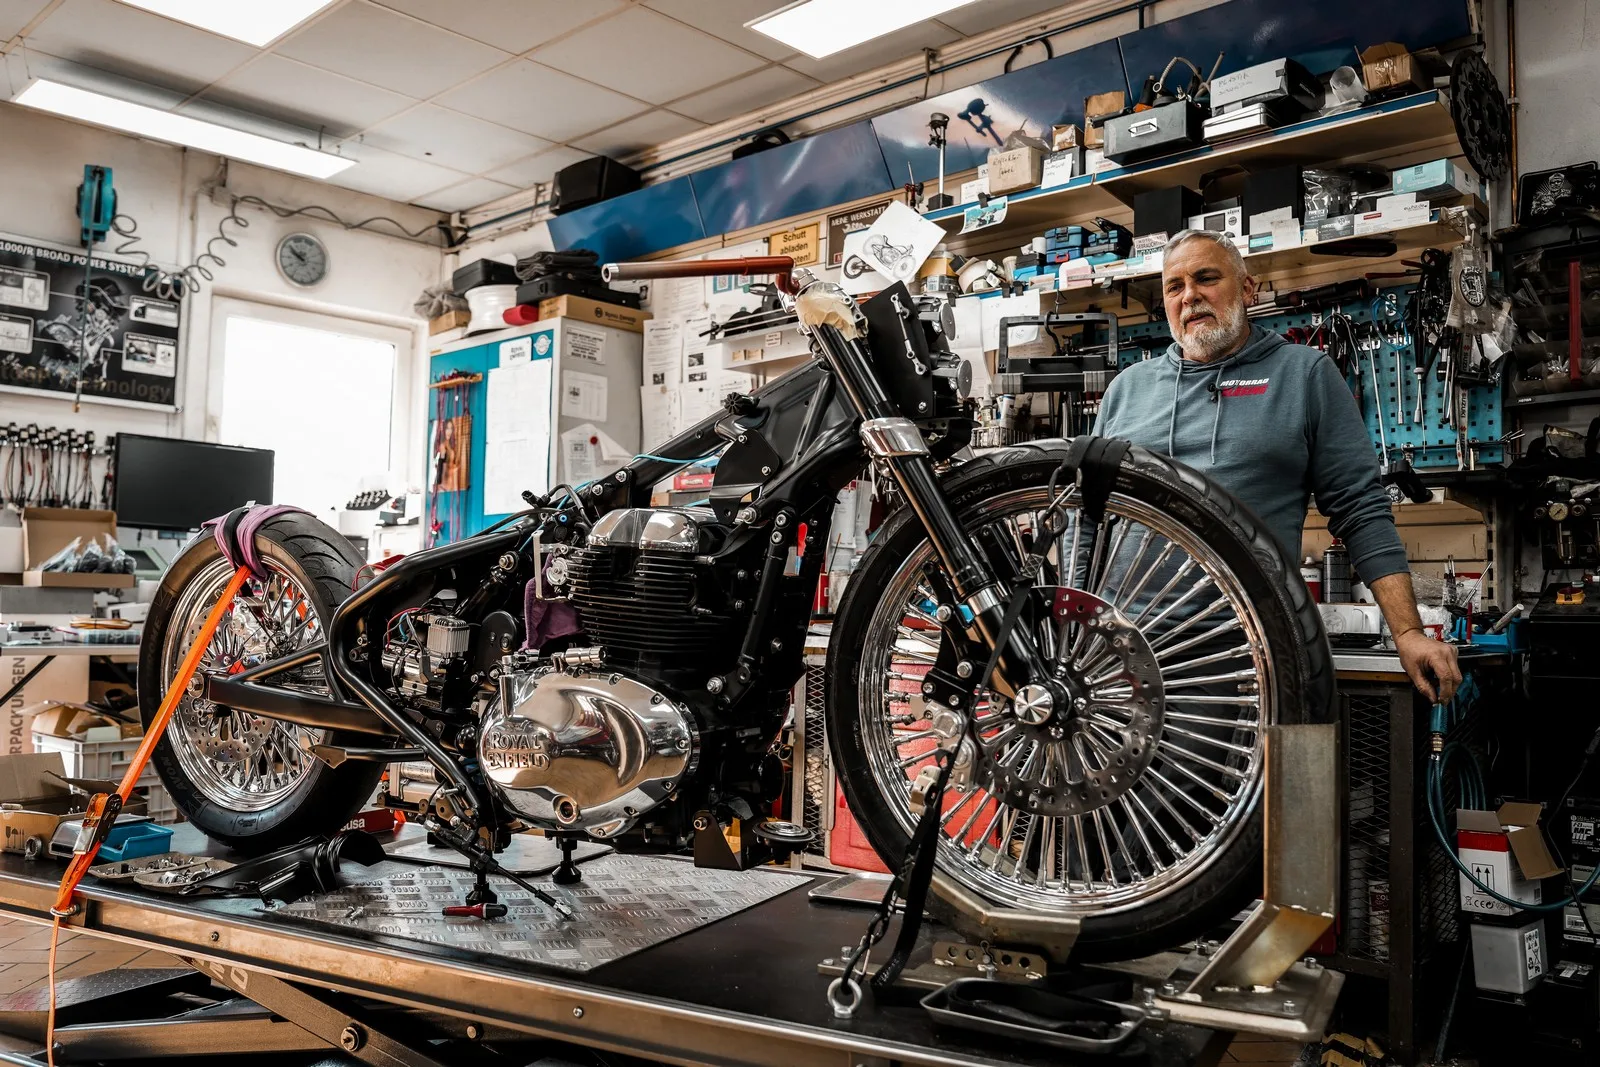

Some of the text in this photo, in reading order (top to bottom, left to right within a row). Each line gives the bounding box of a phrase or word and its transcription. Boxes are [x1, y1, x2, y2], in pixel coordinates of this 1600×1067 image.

[831, 215, 849, 227] MEINE
[782, 230, 807, 243] Schutt
[780, 242, 809, 254] abladen
[36, 249, 71, 263] BROAD
[1219, 378, 1270, 387] MOTORRAD
[490, 731, 542, 751] ROYAL
[486, 752, 551, 771] ENFIELD
